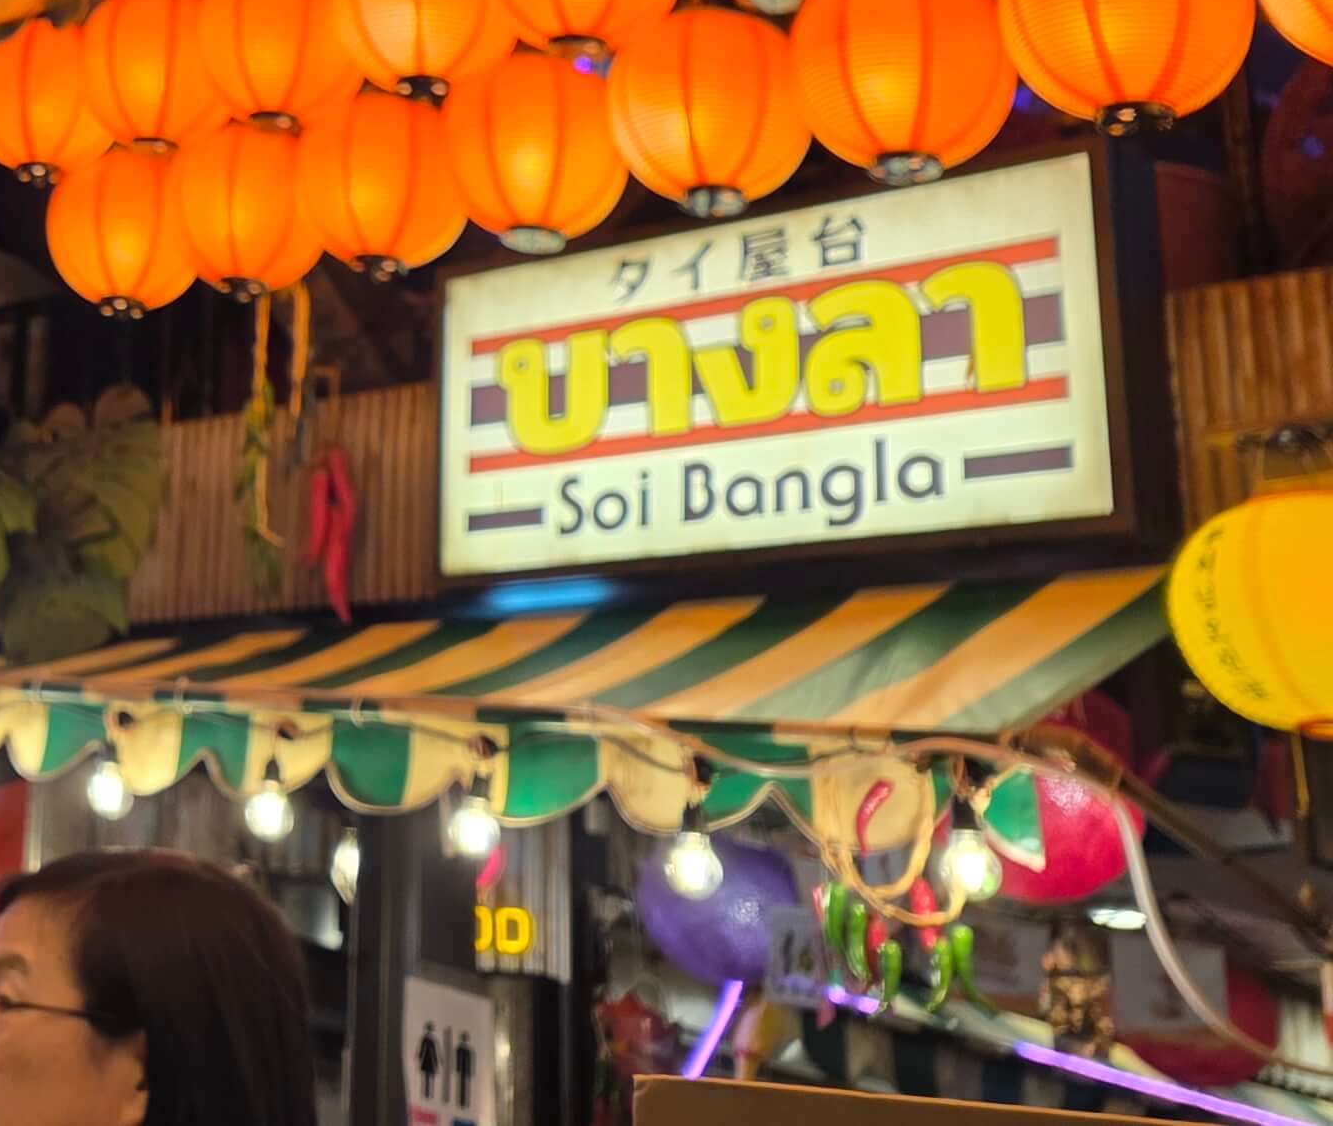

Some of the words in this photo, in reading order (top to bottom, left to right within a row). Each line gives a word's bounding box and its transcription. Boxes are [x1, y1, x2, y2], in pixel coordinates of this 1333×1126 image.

[611, 216, 868, 302] タイ屋台
[497, 260, 1027, 454] บางลา
[558, 474, 651, 537] Soi
[683, 437, 943, 526] Bangla
